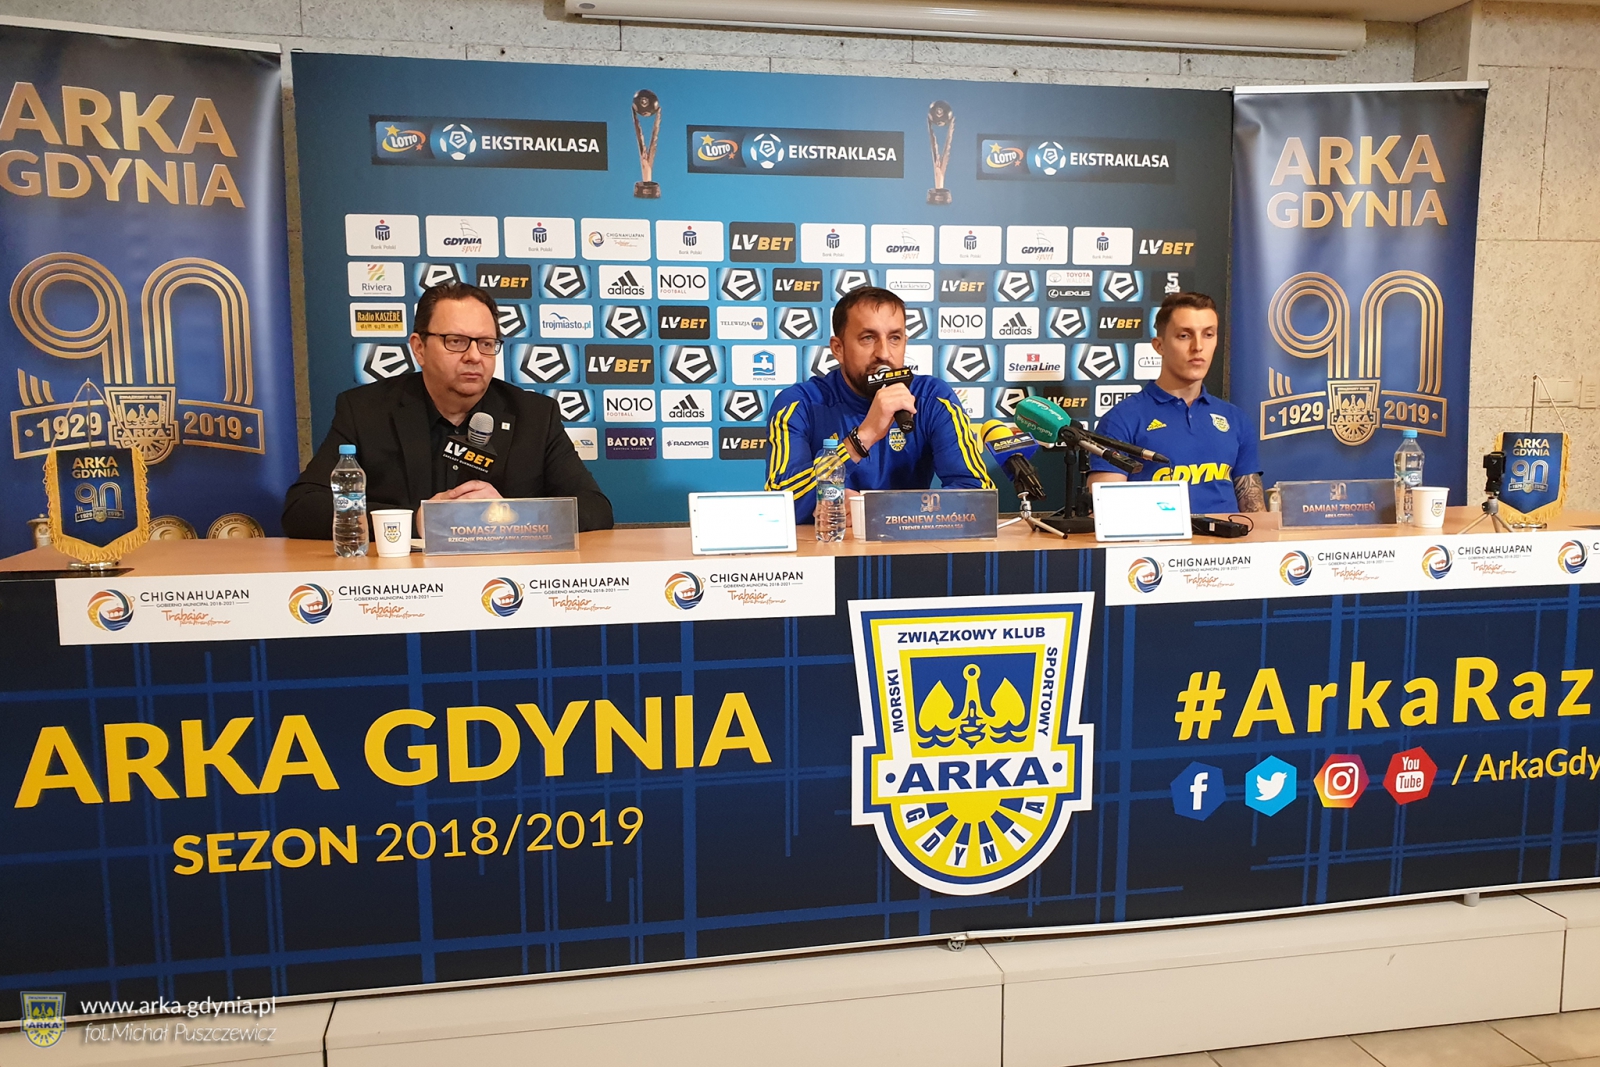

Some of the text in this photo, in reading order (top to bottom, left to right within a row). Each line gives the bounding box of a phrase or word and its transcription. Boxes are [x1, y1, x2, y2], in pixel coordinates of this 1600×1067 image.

[0, 81, 238, 158] ARKA
[390, 133, 600, 153] LOTTO EKSTRAKLASA
[705, 143, 897, 162] LOTTO EKSTRAKLASA
[993, 151, 1170, 168] LOTTO EKSTRAKLASA
[1270, 134, 1446, 186] ARKA
[0, 150, 246, 208] GDYNIA
[1266, 189, 1448, 229] GDYNIA
[443, 237, 483, 246] GDYNIA
[886, 245, 920, 254] GDYNIA
[1021, 246, 1055, 254] GDYNIA
[361, 282, 392, 292] Riviera
[607, 285, 645, 296] adidas
[357, 311, 374, 321] Radio
[542, 319, 592, 331] trojmiasto.pl
[999, 326, 1032, 336] adidas
[1008, 361, 1061, 371] Stena Line
[668, 408, 705, 418] adidas
[1278, 401, 1324, 427] 1929
[1384, 400, 1430, 425] 2019
[37, 411, 103, 442] 1929
[183, 411, 243, 439] 2019
[606, 437, 655, 447] BATORY
[1513, 438, 1550, 449] ARKA
[1512, 448, 1550, 457] GDYNIA
[72, 456, 119, 469] ARKA
[71, 468, 120, 479] GDYNIA
[1302, 504, 1338, 513] DAMIAN
[885, 511, 977, 525] ZBIGNIEW SMÓŁKA
[450, 522, 549, 536] TOMASZ RYBIŃSKI
[1317, 550, 1396, 561] CHIGNAHUAPAN
[1457, 545, 1533, 556] CHIGNAHUAPAN
[1168, 556, 1251, 568] CHIGNAHUAPAN
[1470, 561, 1503, 574] Trabajar
[709, 571, 804, 583] CHIGNAHUAPAN
[1183, 573, 1219, 587] Trabajar
[1331, 566, 1365, 580] Trabajar
[338, 583, 444, 596] CHIGNAHUAPAN
[529, 577, 630, 590] CHIGNAHUAPAN
[140, 589, 250, 602] CHIGNAHUAPAN
[727, 588, 768, 604] Trabajar
[358, 602, 405, 618] Trabajar
[548, 595, 592, 611] Trabajar
[161, 608, 209, 625] Trabajar
[897, 626, 1046, 645] ZWIĄZKOWY KLUB
[1037, 646, 1058, 737] SPORTOWY
[886, 668, 905, 733] MORSKI
[14, 692, 773, 809] ARKA GDYNIA
[1401, 756, 1420, 771] You
[897, 756, 1050, 794] ARKA
[1398, 774, 1422, 790] Tube
[172, 806, 644, 876] SEZON 2018/2019
